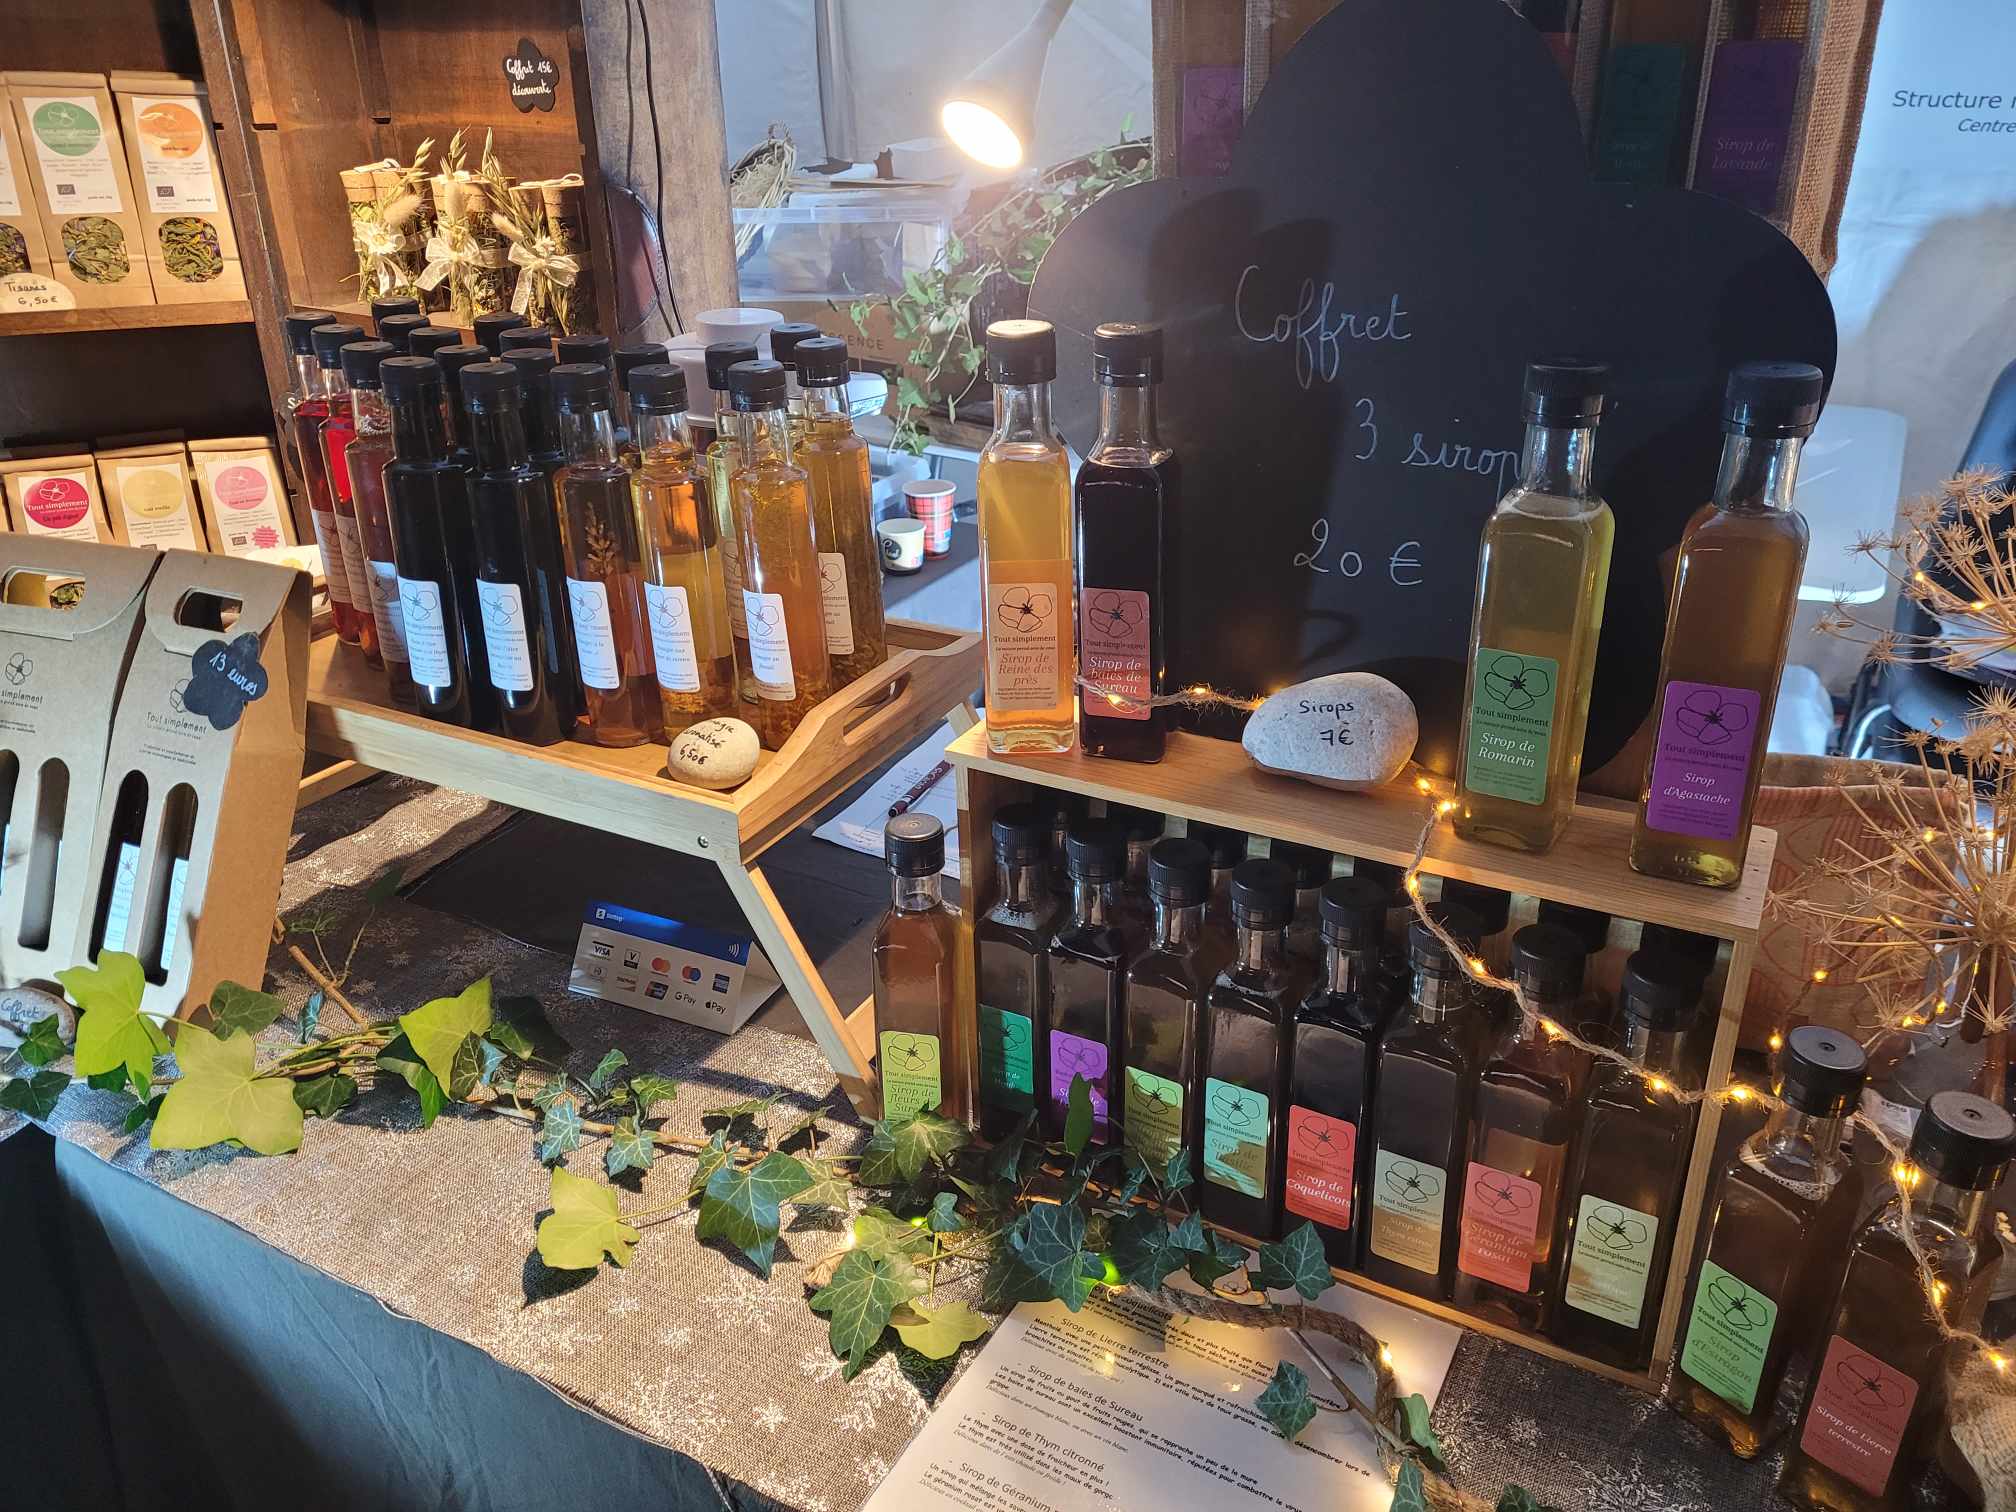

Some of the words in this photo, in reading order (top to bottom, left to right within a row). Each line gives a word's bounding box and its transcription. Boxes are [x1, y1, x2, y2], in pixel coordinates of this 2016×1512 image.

[506, 58, 534, 80] Coffret
[1892, 90, 2002, 109] Structure
[1958, 118, 2016, 133] Centre
[1235, 265, 1412, 390] Coffret
[1355, 398, 1378, 460] 3
[1389, 541, 1423, 586] €
[1012, 634, 1057, 644] simplement
[998, 664, 1031, 675] Reine
[1033, 664, 1053, 675] des
[1001, 653, 1032, 665] Sirop
[1035, 653, 1050, 664] de
[1089, 656, 1123, 672] Sirop
[1126, 659, 1141, 671] de
[208, 652, 227, 673] 13
[228, 666, 259, 696] euros
[1126, 671, 1143, 682] de
[1, 689, 44, 705] simplement
[1298, 700, 1355, 720] Sirops
[1475, 706, 1496, 718] Tout
[1497, 711, 1549, 728] simplement
[165, 717, 207, 734] simplement
[1320, 728, 1355, 747] 7€
[1480, 732, 1516, 750] Sirop
[1519, 739, 1536, 753] de
[1478, 747, 1536, 768] Romarin
[1664, 743, 1686, 753] Tout
[1687, 746, 1746, 762] simplement
[1683, 772, 1715, 786] Sirop
[1663, 786, 1731, 806] d'Agastache
[594, 945, 611, 958] VISA
[684, 993, 697, 1005] Pay
[711, 1001, 727, 1015] Pay
[888, 1093, 920, 1105] fleurs
[891, 1084, 918, 1098] Sirop
[922, 1088, 934, 1097] de
[1206, 1118, 1222, 1128] Tout
[1222, 1125, 1262, 1141] simplement
[1211, 1138, 1240, 1156] Sirop
[1296, 1168, 1326, 1188] Sirop
[1328, 1181, 1344, 1193] de
[1471, 1222, 1505, 1242] Sirop
[1508, 1235, 1522, 1247] de
[1577, 1240, 1596, 1252] Tout
[1597, 1248, 1646, 1268] simplement
[1697, 1305, 1715, 1320] Tout
[1716, 1319, 1764, 1354] simplement
[1061, 1318, 1084, 1334] Sirop
[1087, 1329, 1098, 1338] de
[1100, 1334, 1126, 1350] Lierre
[1129, 1346, 1169, 1368] terrestre
[1028, 1365, 1052, 1382] Sirop
[1054, 1376, 1066, 1387] de
[1068, 1382, 1093, 1399] baies
[1095, 1394, 1107, 1405] de
[1109, 1401, 1144, 1421] Sureau
[1081, 1401, 1090, 1409] de
[1091, 1406, 1111, 1418] fruits
[1137, 1427, 1148, 1436] qui
[1158, 1436, 1194, 1457] rapproche
[1204, 1458, 1217, 1468] peu
[1219, 1464, 1229, 1472] de
[1815, 1405, 1844, 1426] Sirop
[1845, 1423, 1859, 1435] de
[1860, 1433, 1892, 1456] Lierre
[962, 1414, 972, 1422] Le
[972, 1419, 990, 1431] thym
[990, 1428, 1004, 1438] avec
[1006, 1436, 1018, 1444] une
[1019, 1441, 1035, 1452] dose
[1036, 1449, 1046, 1457] de
[1088, 1474, 1104, 1486] plus
[992, 1414, 1017, 1432] Sirop
[1019, 1427, 1032, 1438] de
[1033, 1433, 1061, 1453] Thym
[1063, 1447, 1104, 1472] citronné
[1828, 1427, 1872, 1457] terrestre
[958, 1421, 967, 1429] Le
[967, 1426, 985, 1439] thym
[985, 1434, 997, 1444] est
[998, 1440, 1012, 1451] très
[1013, 1447, 1034, 1461] utilisé
[1035, 1458, 1051, 1469] dans
[1051, 1466, 1062, 1475] les
[1063, 1473, 1082, 1485] maux
[1082, 1481, 1093, 1490] de
[1081, 1411, 1111, 1428] excellent
[1185, 1458, 1218, 1477] réputées
[1218, 1474, 1235, 1486] pour
[1236, 1481, 1273, 1502] combattre
[1275, 1498, 1282, 1506] le
[923, 1470, 932, 1478] Le
[932, 1475, 963, 1495] géranium
[963, 1490, 982, 1503] rosat
[983, 1500, 995, 1510] est
[957, 1476, 969, 1486] qui
[968, 1482, 996, 1500] mélange
[997, 1496, 1008, 1504] les
[959, 1463, 985, 1482] Sirop
[987, 1476, 1000, 1488] de
[1002, 1483, 1051, 1511] Géranium
